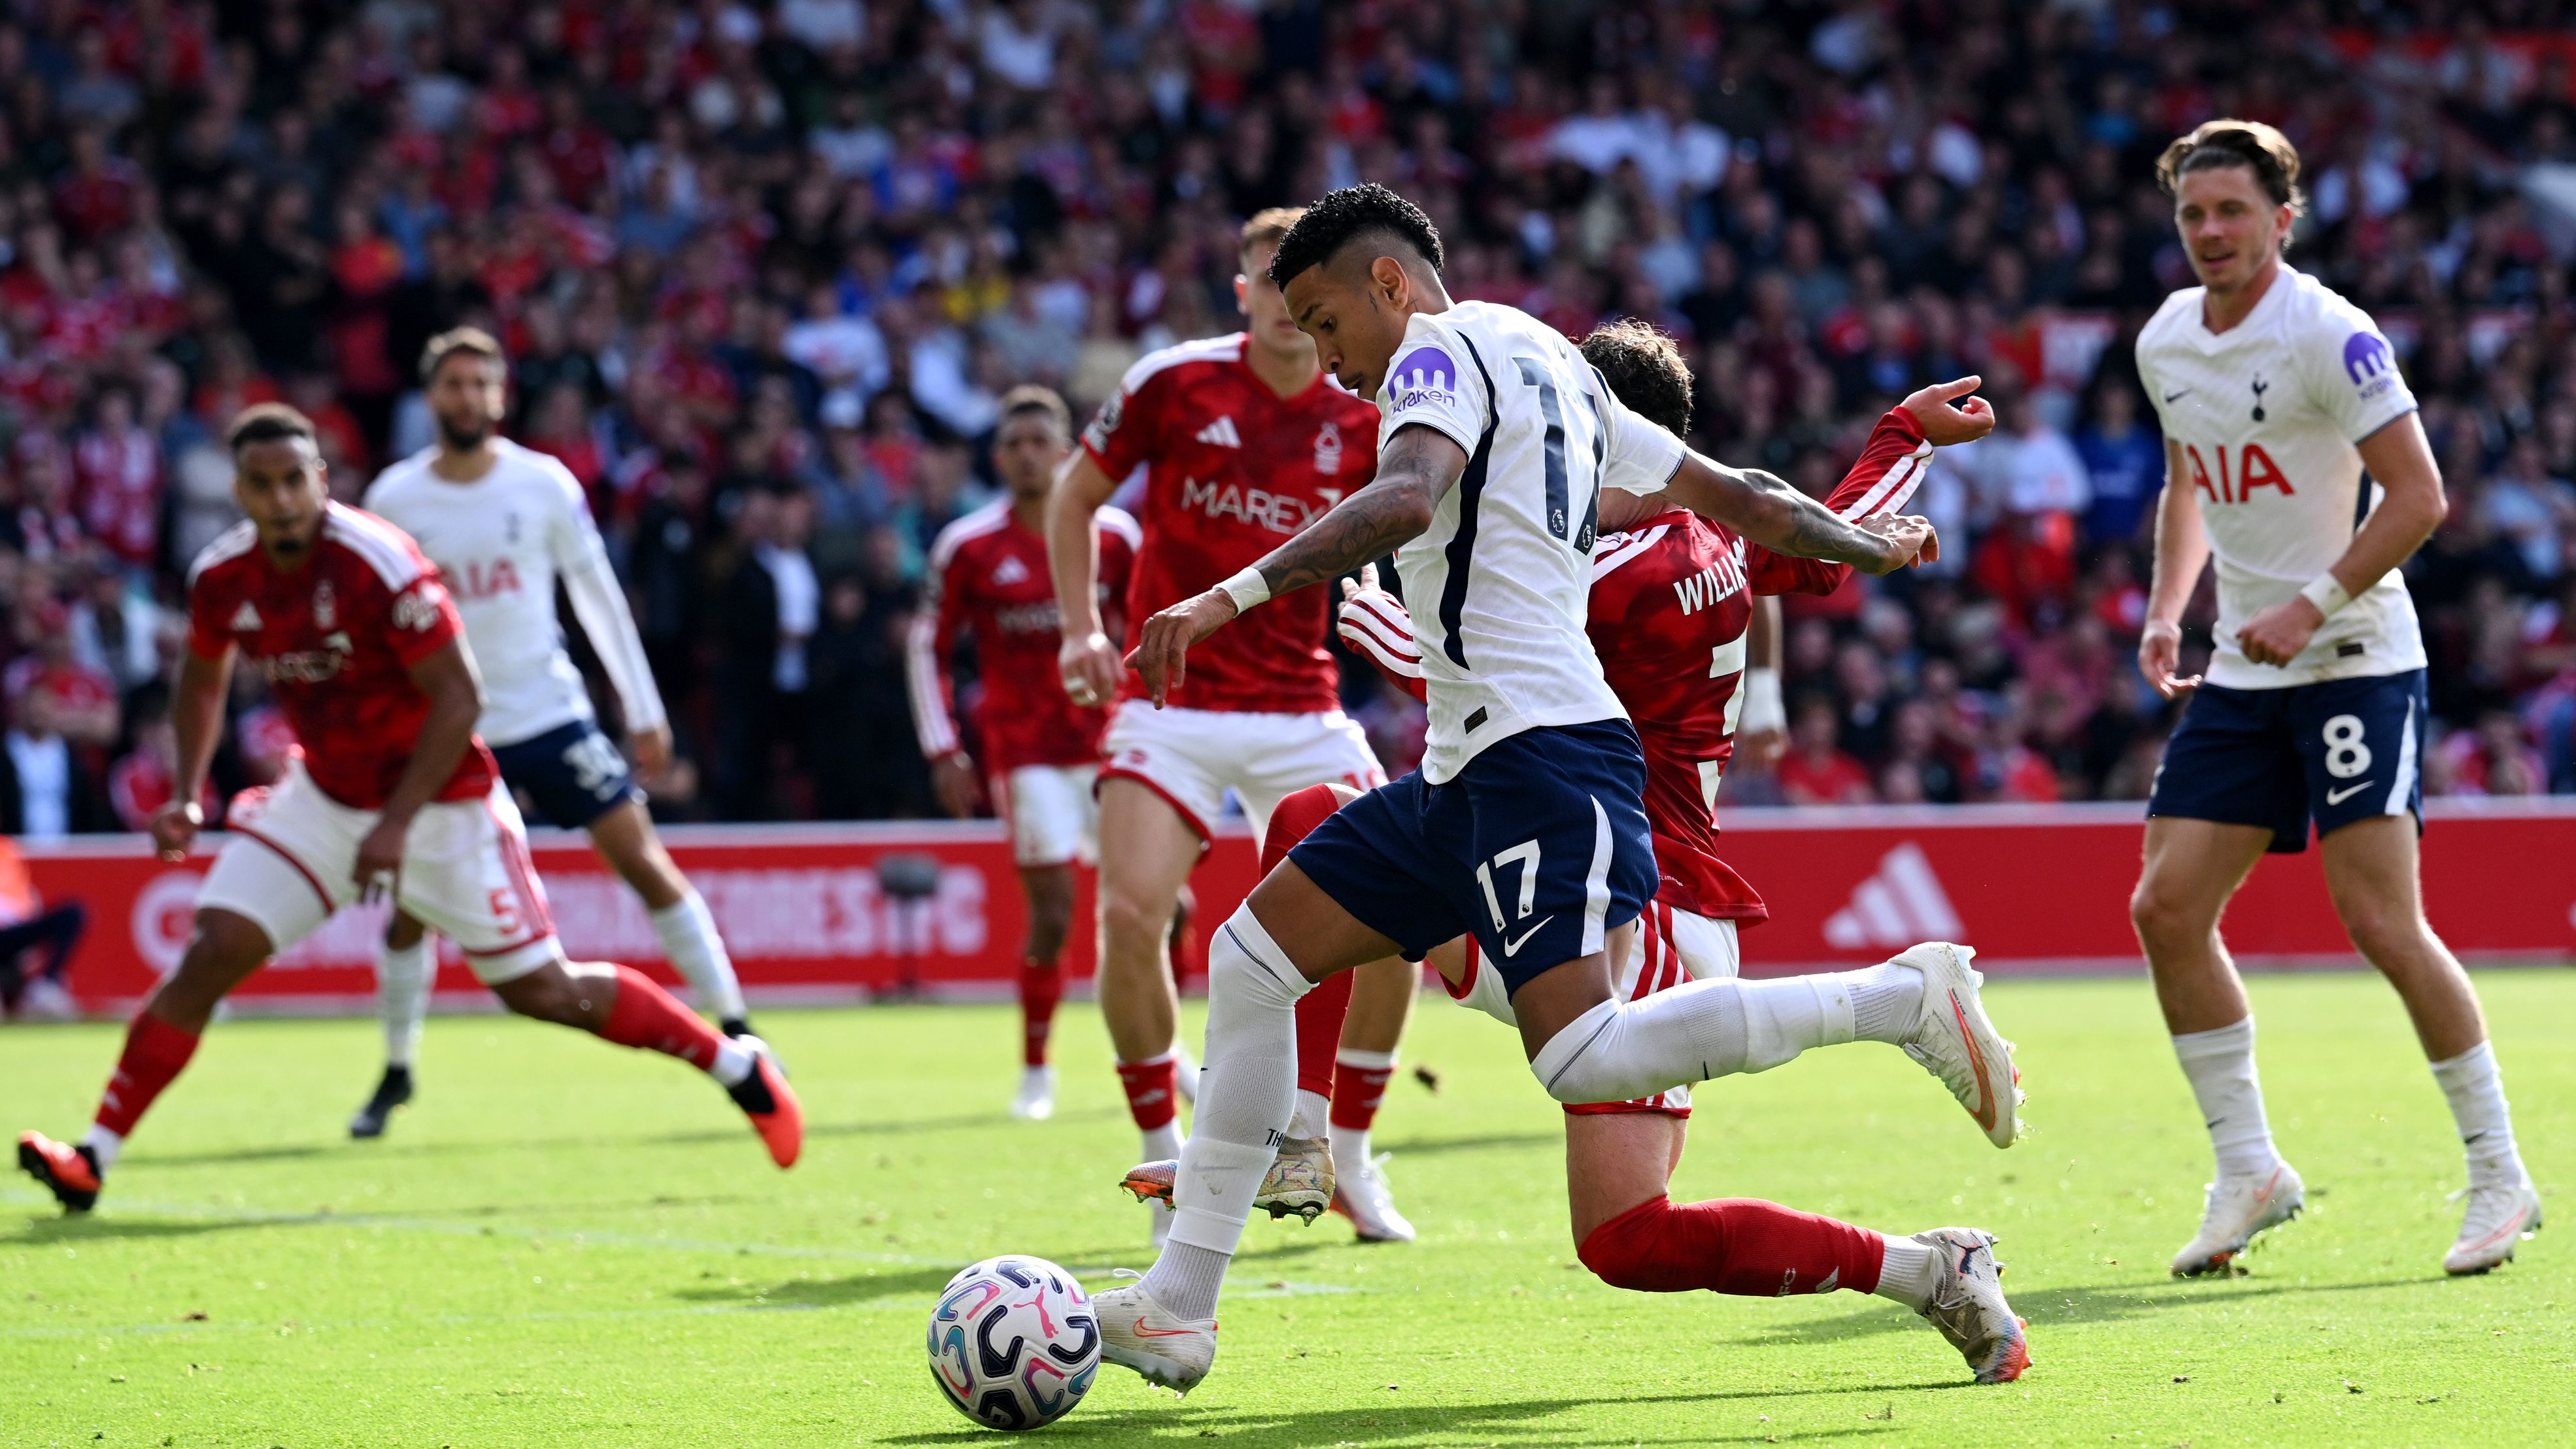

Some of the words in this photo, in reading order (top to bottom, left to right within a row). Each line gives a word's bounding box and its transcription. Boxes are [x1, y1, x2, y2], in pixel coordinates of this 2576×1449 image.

[1392, 390, 1455, 415] kraken
[1512, 357, 1608, 556] 17
[2322, 714, 2372, 778] 8
[488, 888, 522, 936] 5
[1476, 839, 1541, 934] 17
